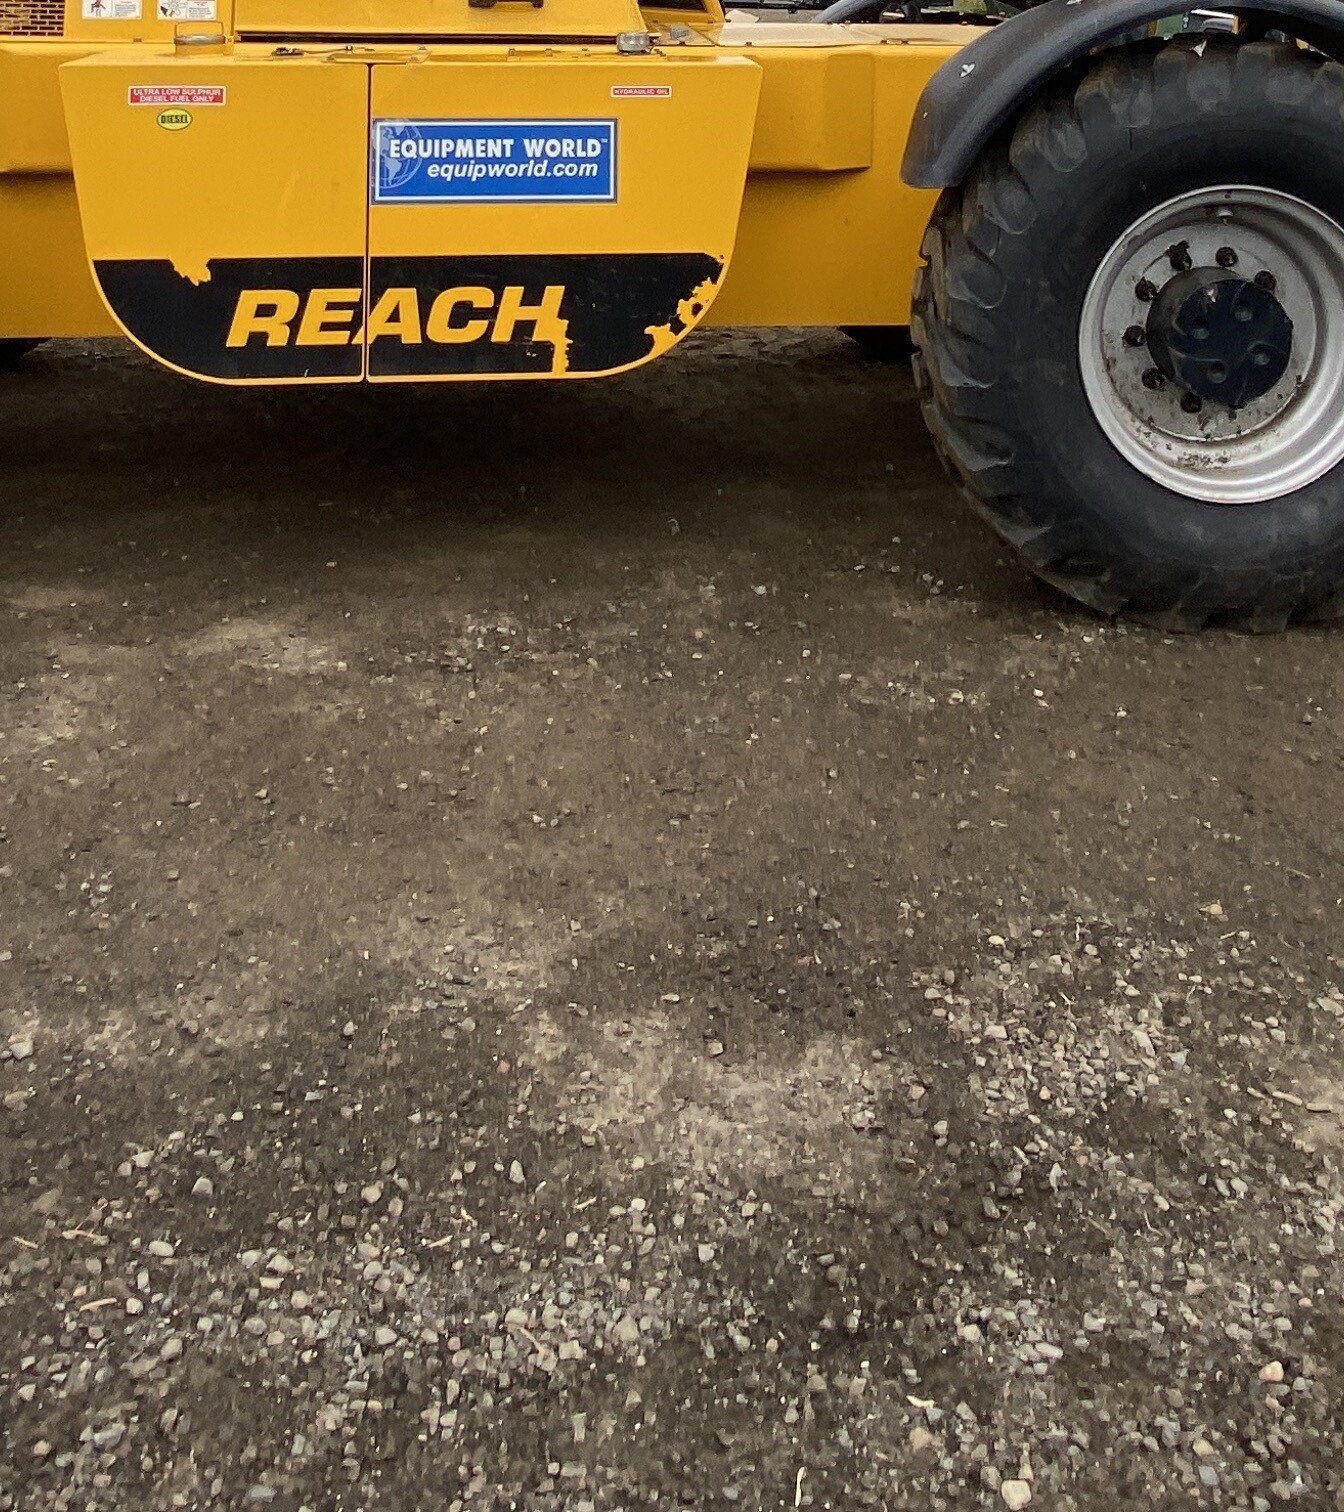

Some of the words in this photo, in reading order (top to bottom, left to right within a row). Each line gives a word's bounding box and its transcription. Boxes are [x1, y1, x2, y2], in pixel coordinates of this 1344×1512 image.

[133, 88, 160, 96] ULTRA
[161, 88, 181, 96] LOW
[139, 95, 169, 103] DIESEL
[170, 95, 192, 103] FUEL
[192, 95, 215, 103] ONLY
[160, 114, 189, 124] DIESEL
[389, 138, 514, 158] EQUIPMENT
[523, 138, 602, 158] WORLD
[427, 159, 598, 181] equipworld.com
[225, 285, 568, 348] REACH
